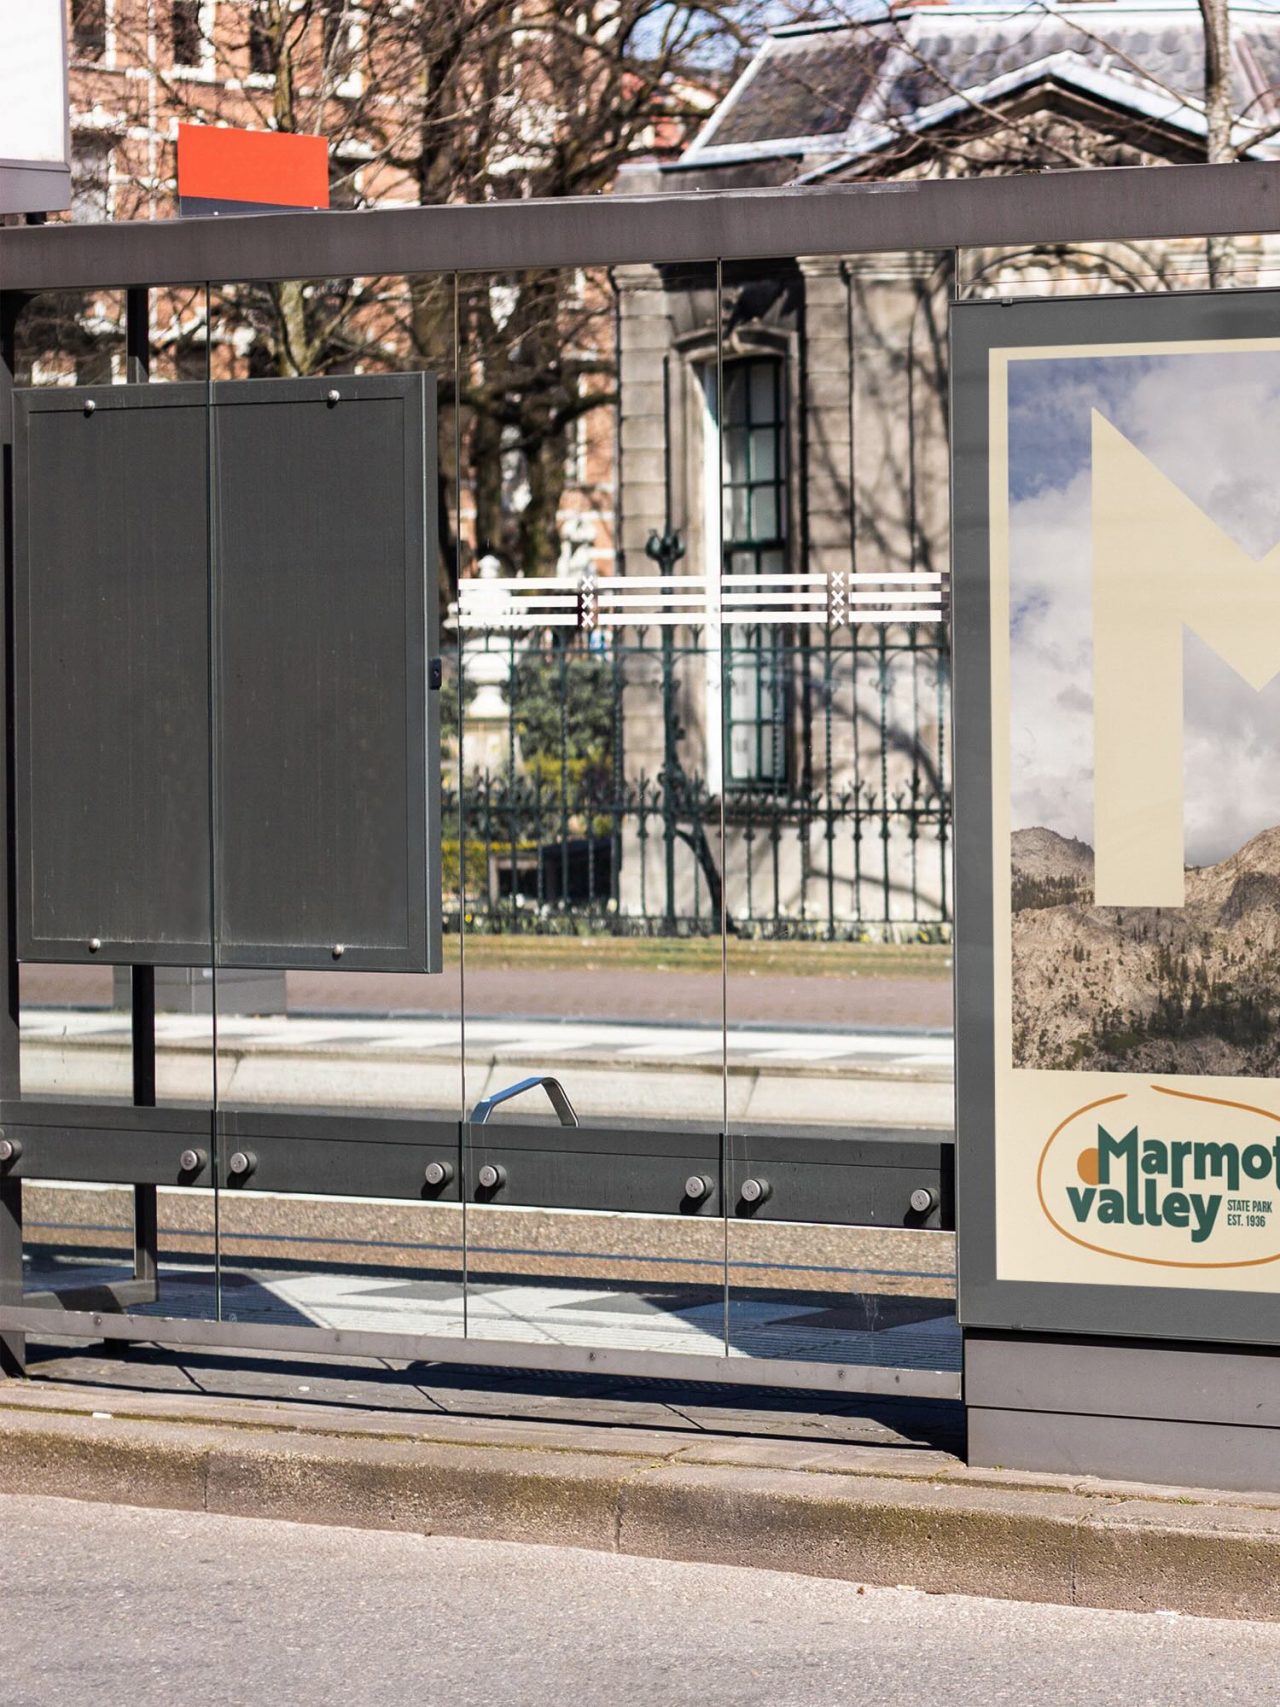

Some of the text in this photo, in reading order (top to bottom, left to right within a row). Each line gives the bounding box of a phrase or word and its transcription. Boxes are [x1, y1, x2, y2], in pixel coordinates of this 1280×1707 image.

[1066, 1179, 1223, 1243] valley
[1227, 1199, 1273, 1213] STATE PARK
[1227, 1214, 1266, 1228] EST. 1936
